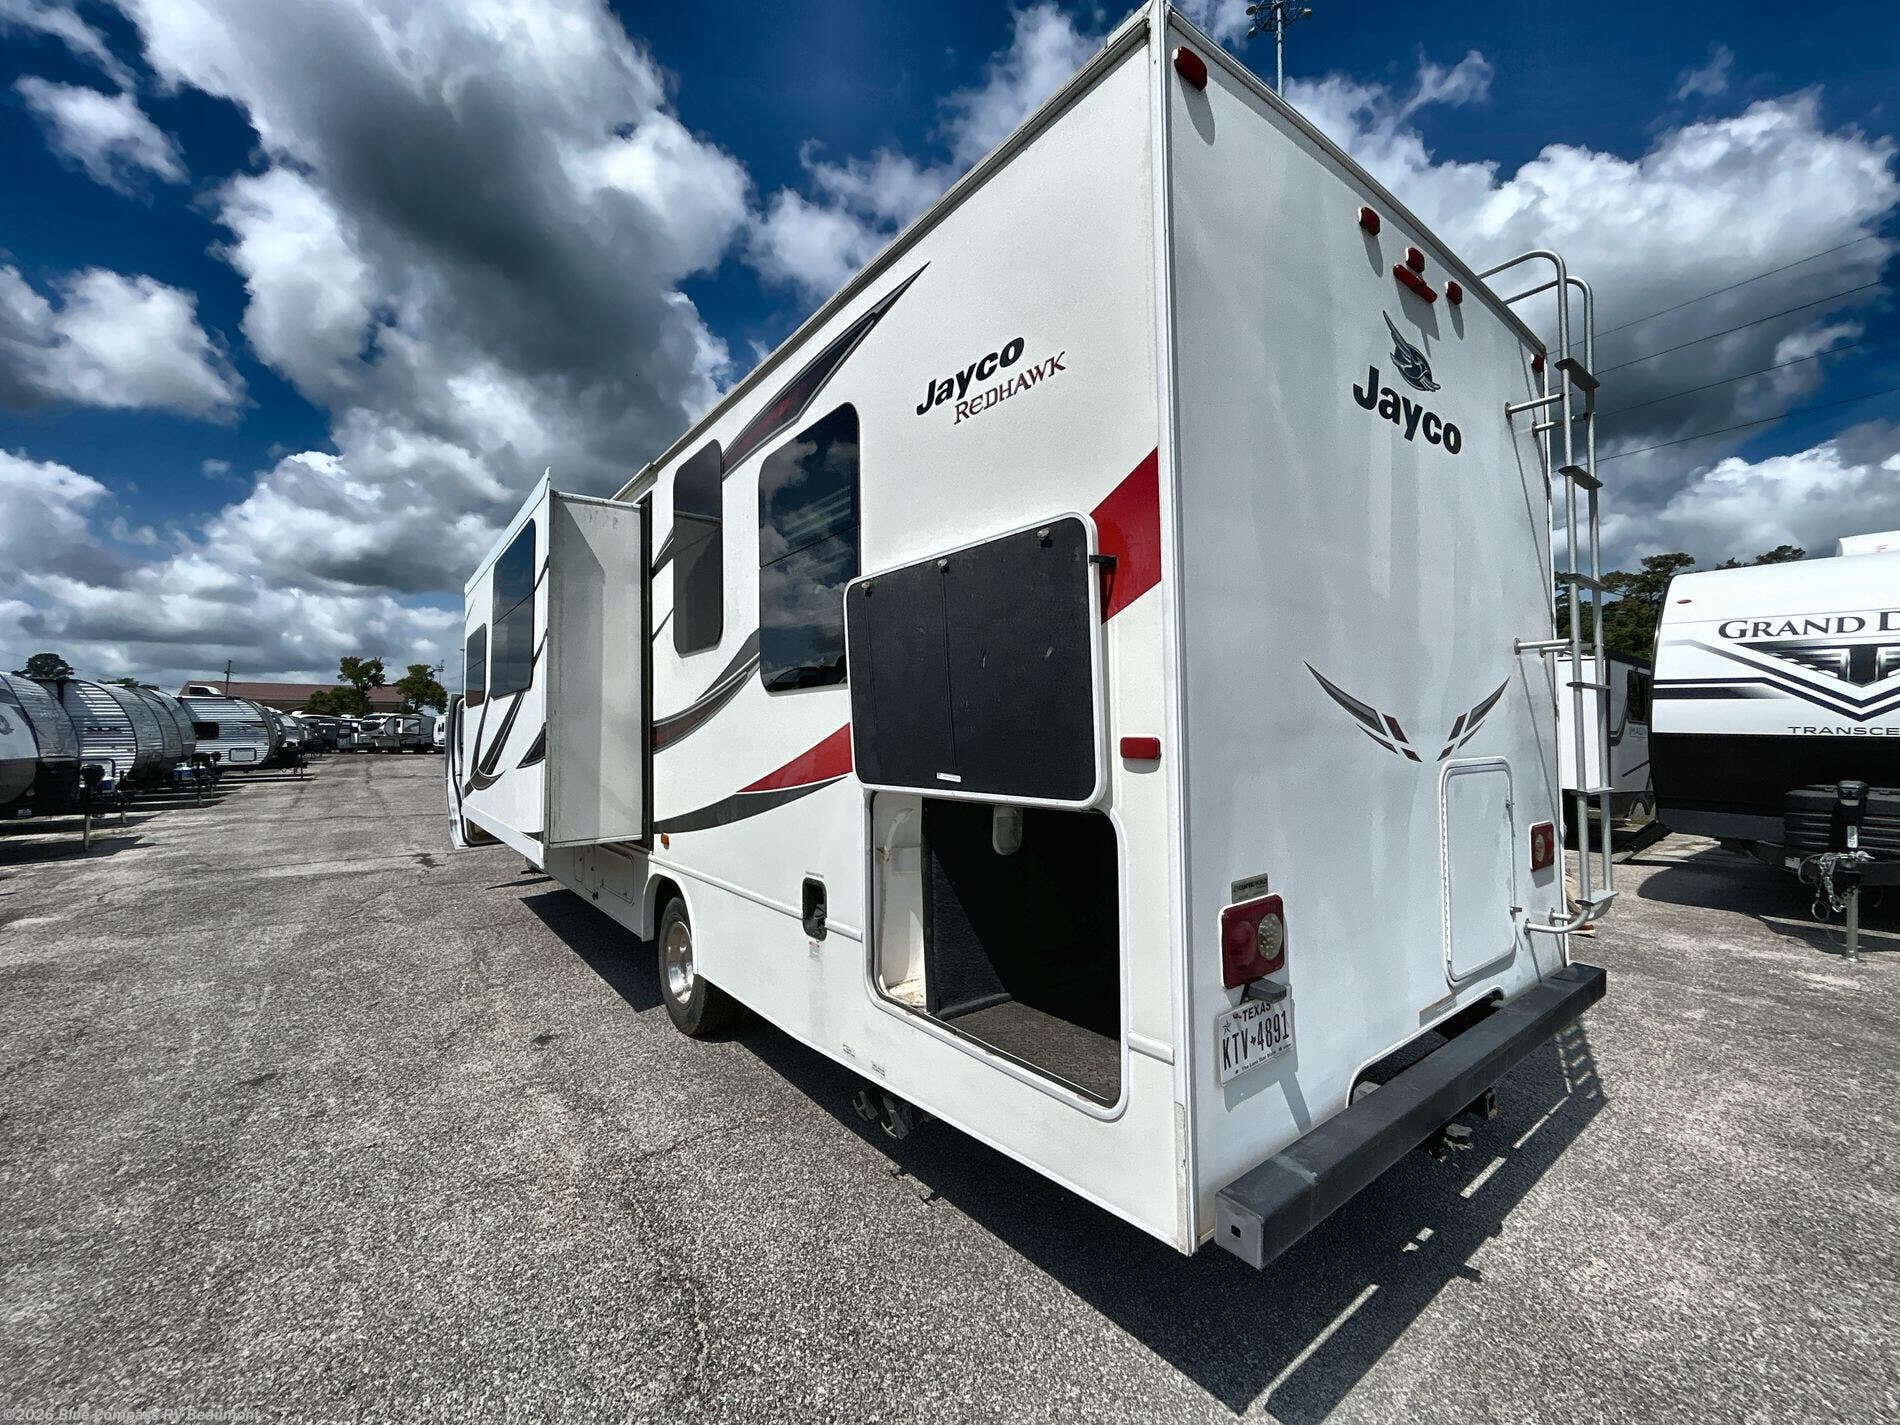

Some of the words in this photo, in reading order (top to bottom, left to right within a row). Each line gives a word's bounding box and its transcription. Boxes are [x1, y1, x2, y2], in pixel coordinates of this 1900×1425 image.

[916, 337, 1025, 416] Jayco
[1353, 365, 1462, 455] Jayco
[1718, 616, 1866, 639] GRAND
[1787, 727, 1900, 736] TRANSCE
[1242, 1002, 1271, 1022] TEXAS
